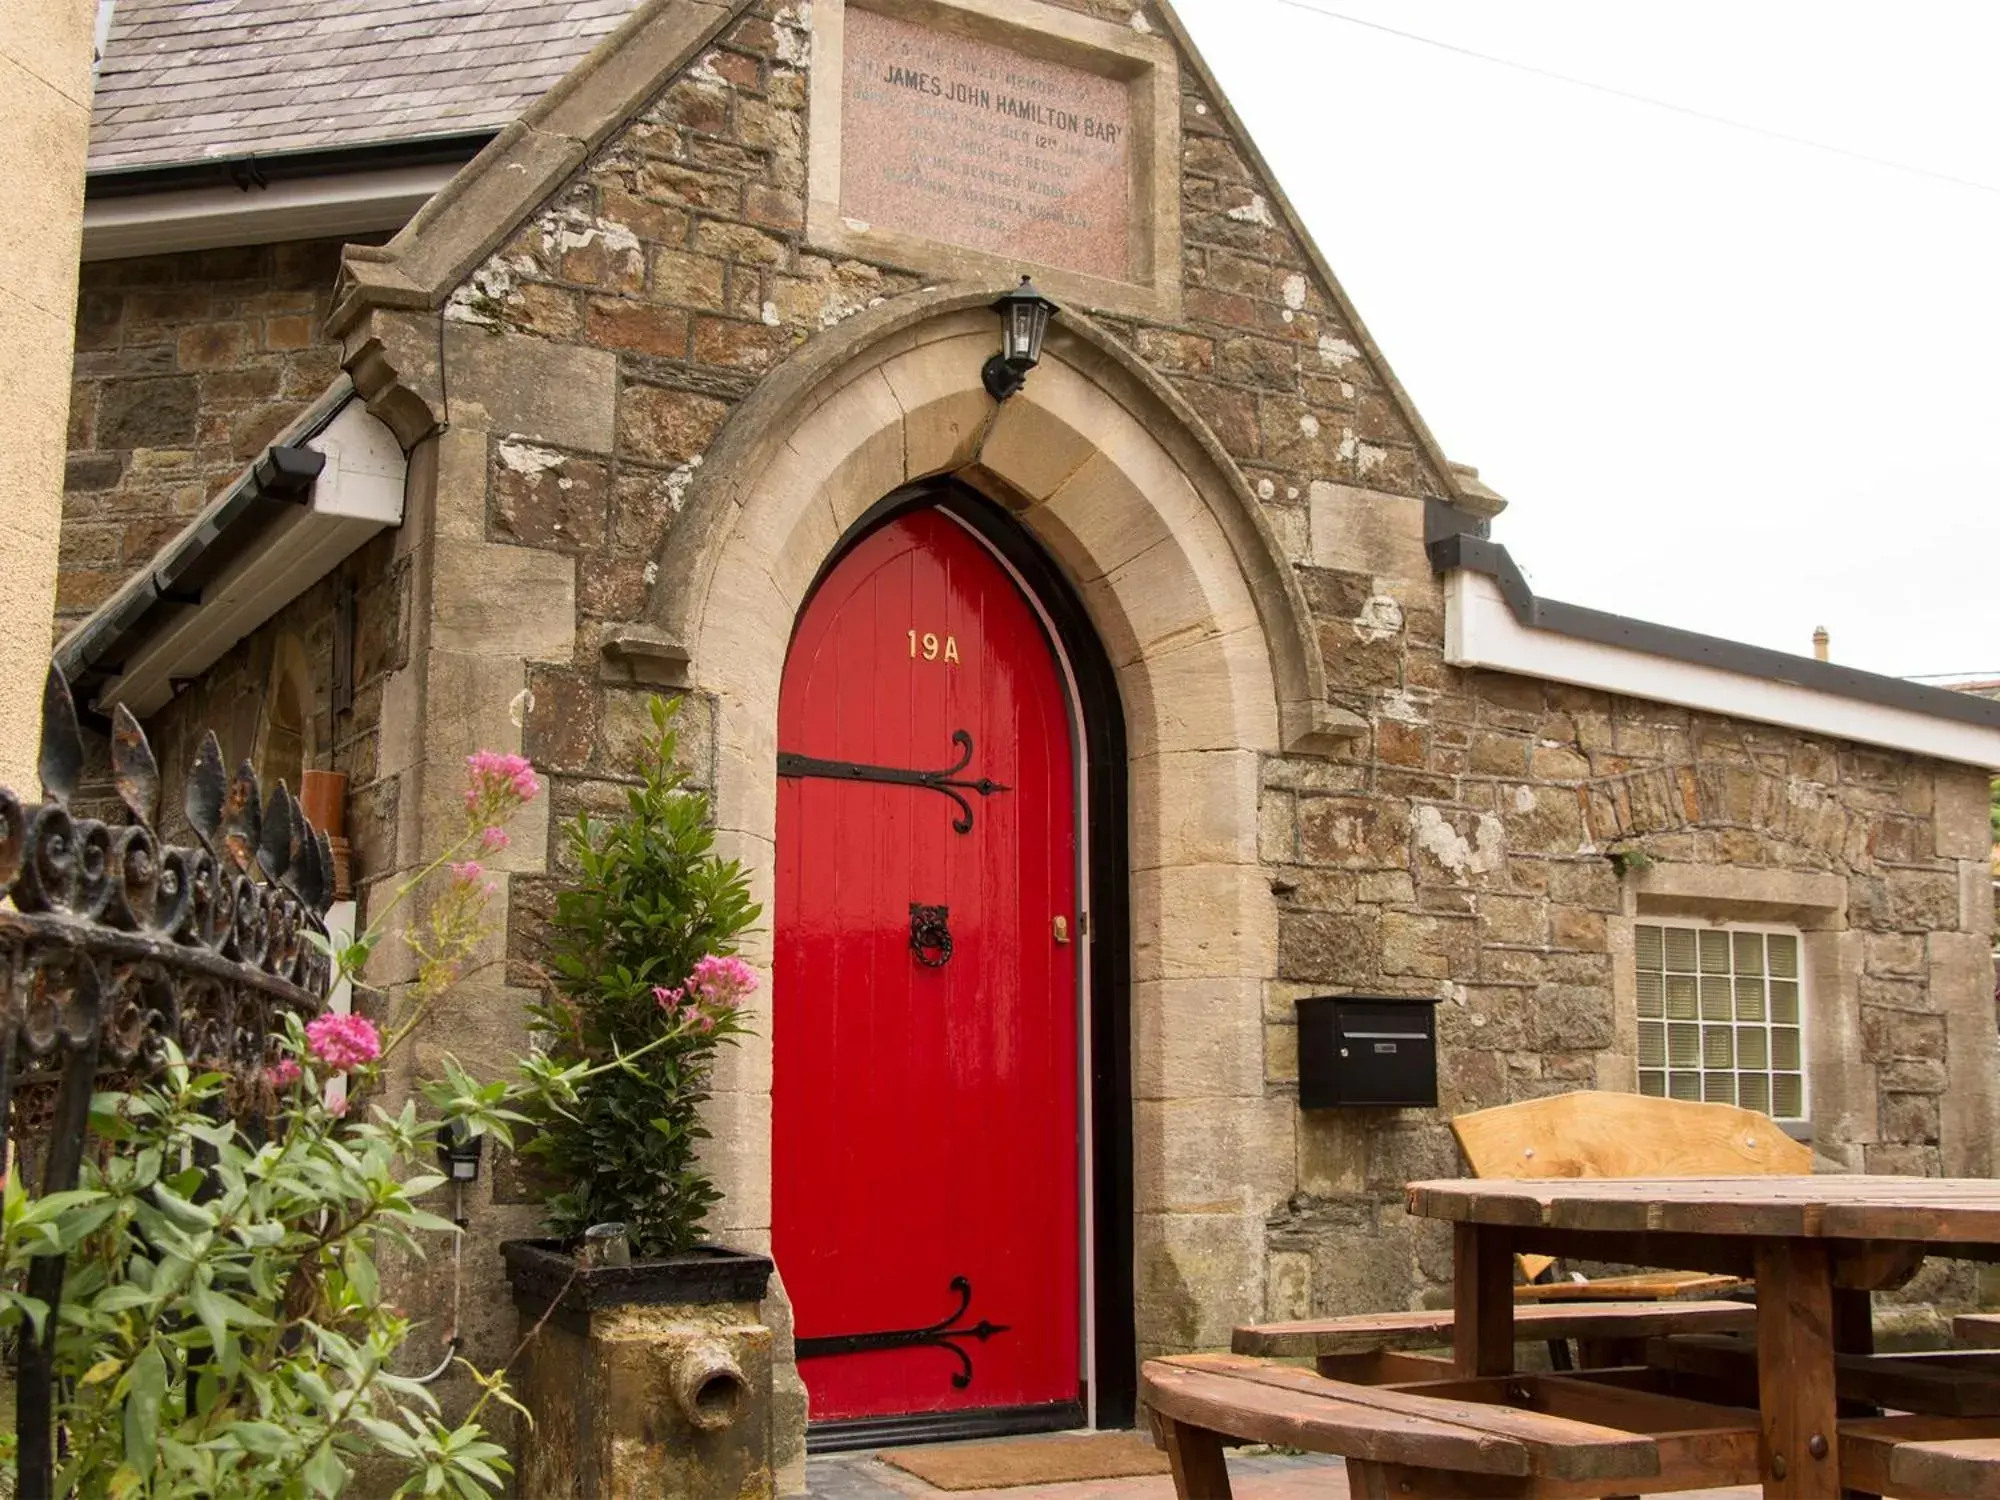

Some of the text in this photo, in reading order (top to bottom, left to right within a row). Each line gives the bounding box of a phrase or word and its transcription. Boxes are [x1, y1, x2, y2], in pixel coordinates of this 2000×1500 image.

[883, 63, 941, 97] JAMES
[945, 79, 989, 110] JOHN
[997, 93, 1077, 133] HAMILTON
[907, 629, 959, 664] 19A
